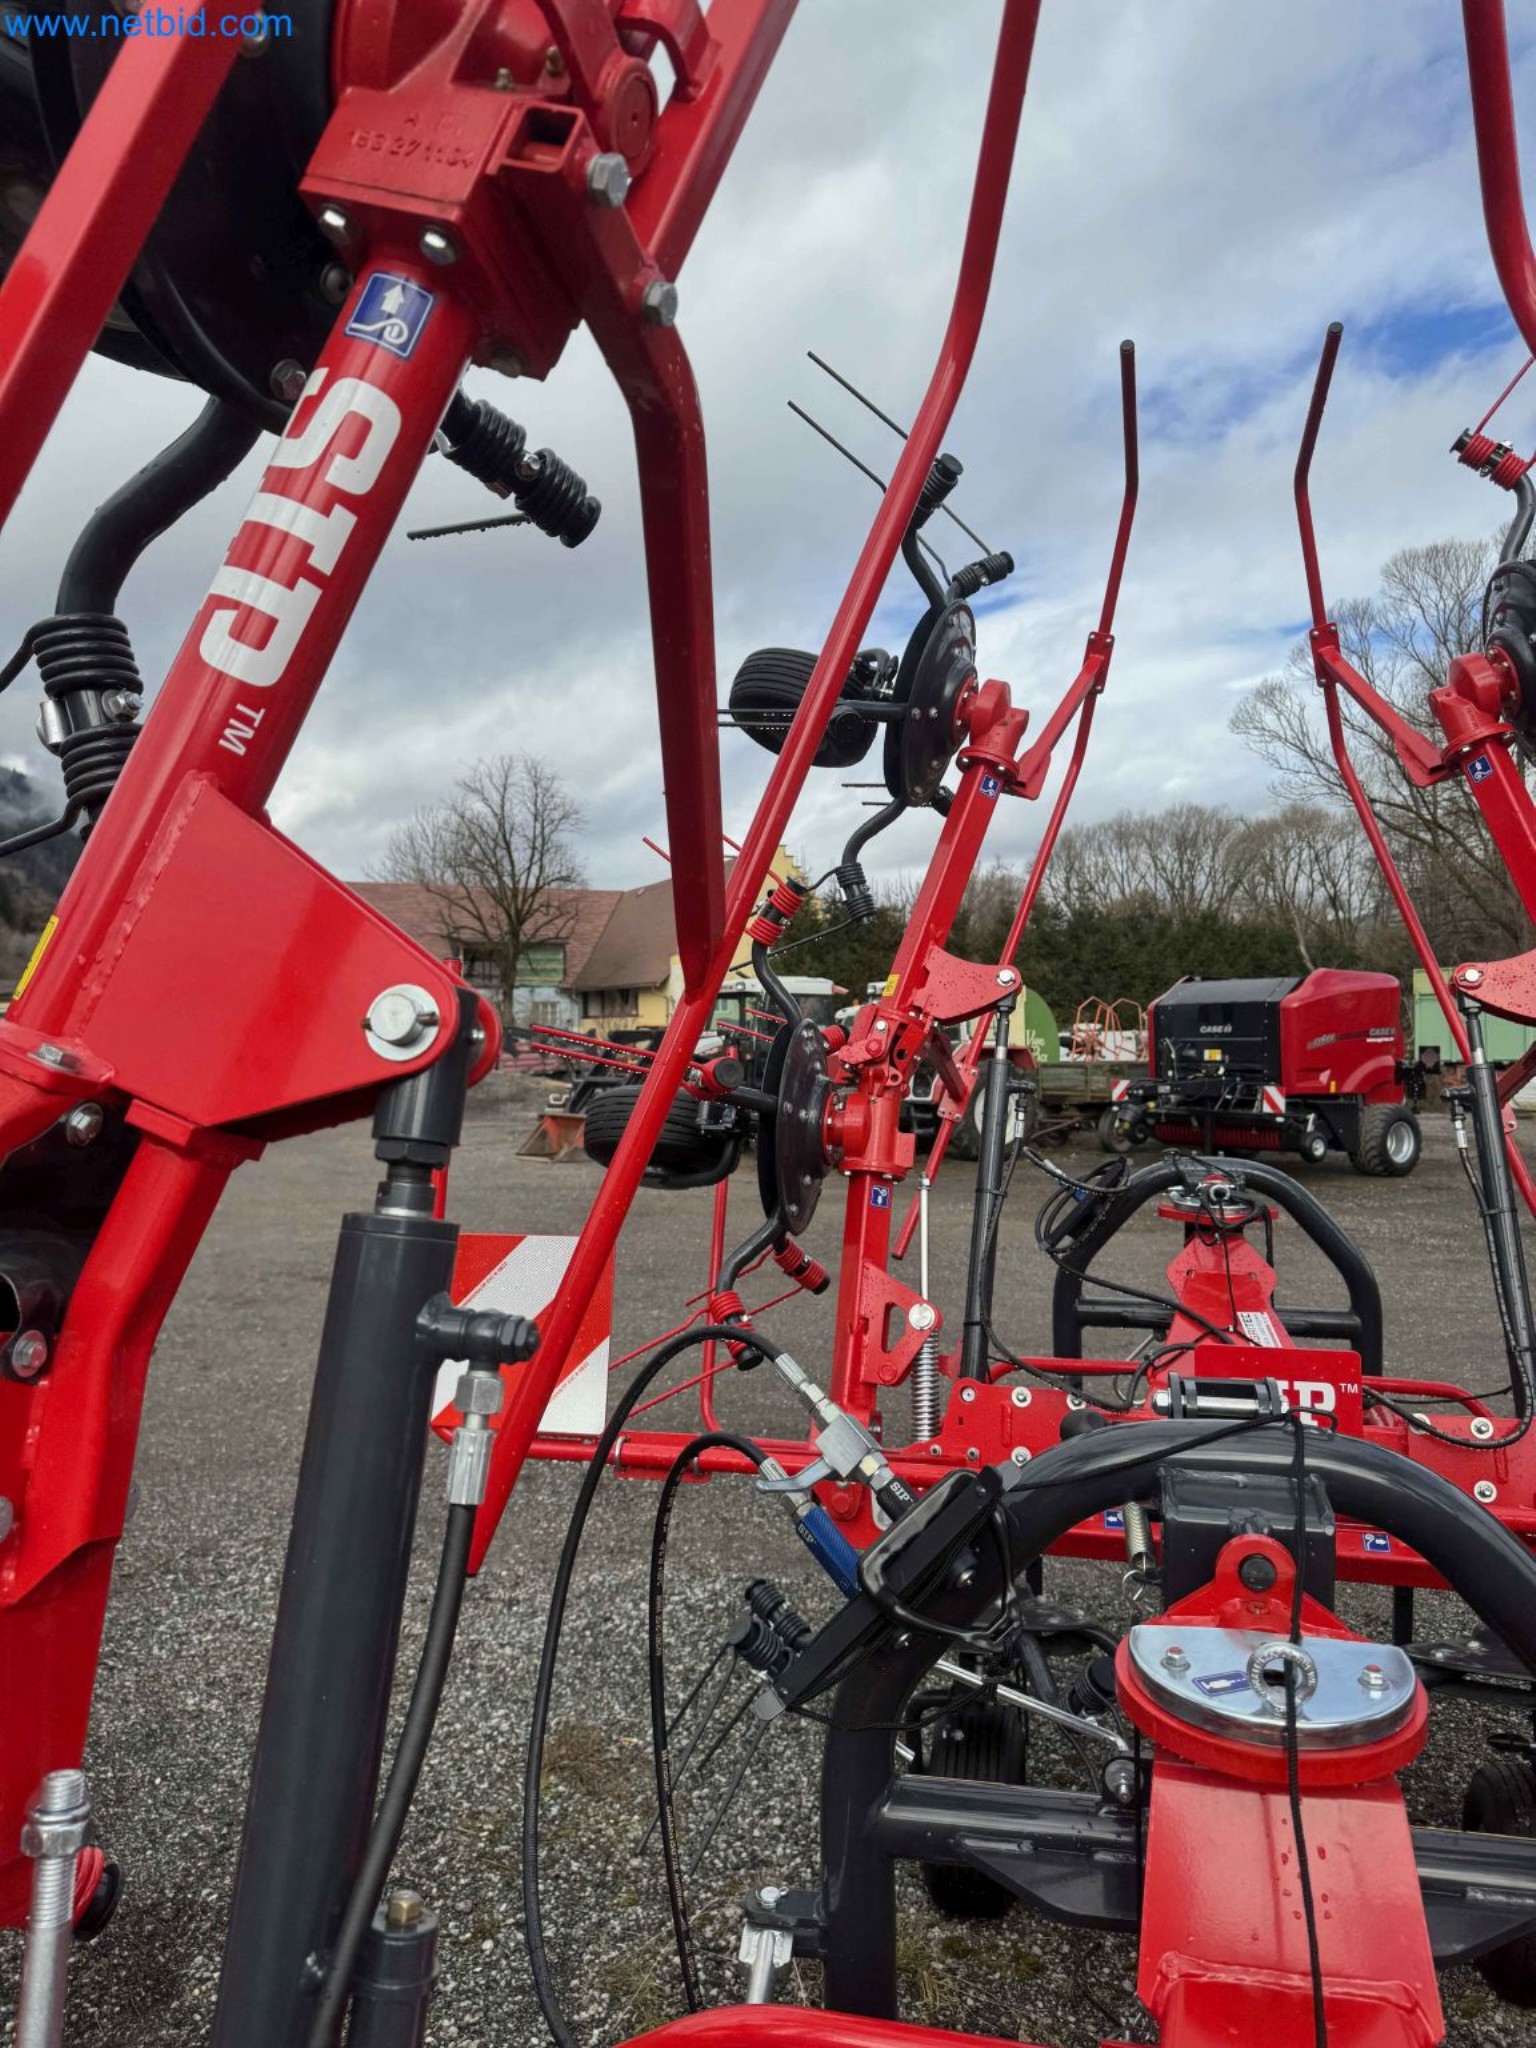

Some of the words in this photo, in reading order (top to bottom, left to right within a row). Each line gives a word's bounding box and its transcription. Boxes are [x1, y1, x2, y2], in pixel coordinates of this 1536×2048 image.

[200, 367, 402, 687] SIP
[218, 703, 266, 757] TM
[1199, 1024, 1223, 1033] CASE
[889, 1481, 911, 1502] SIP
